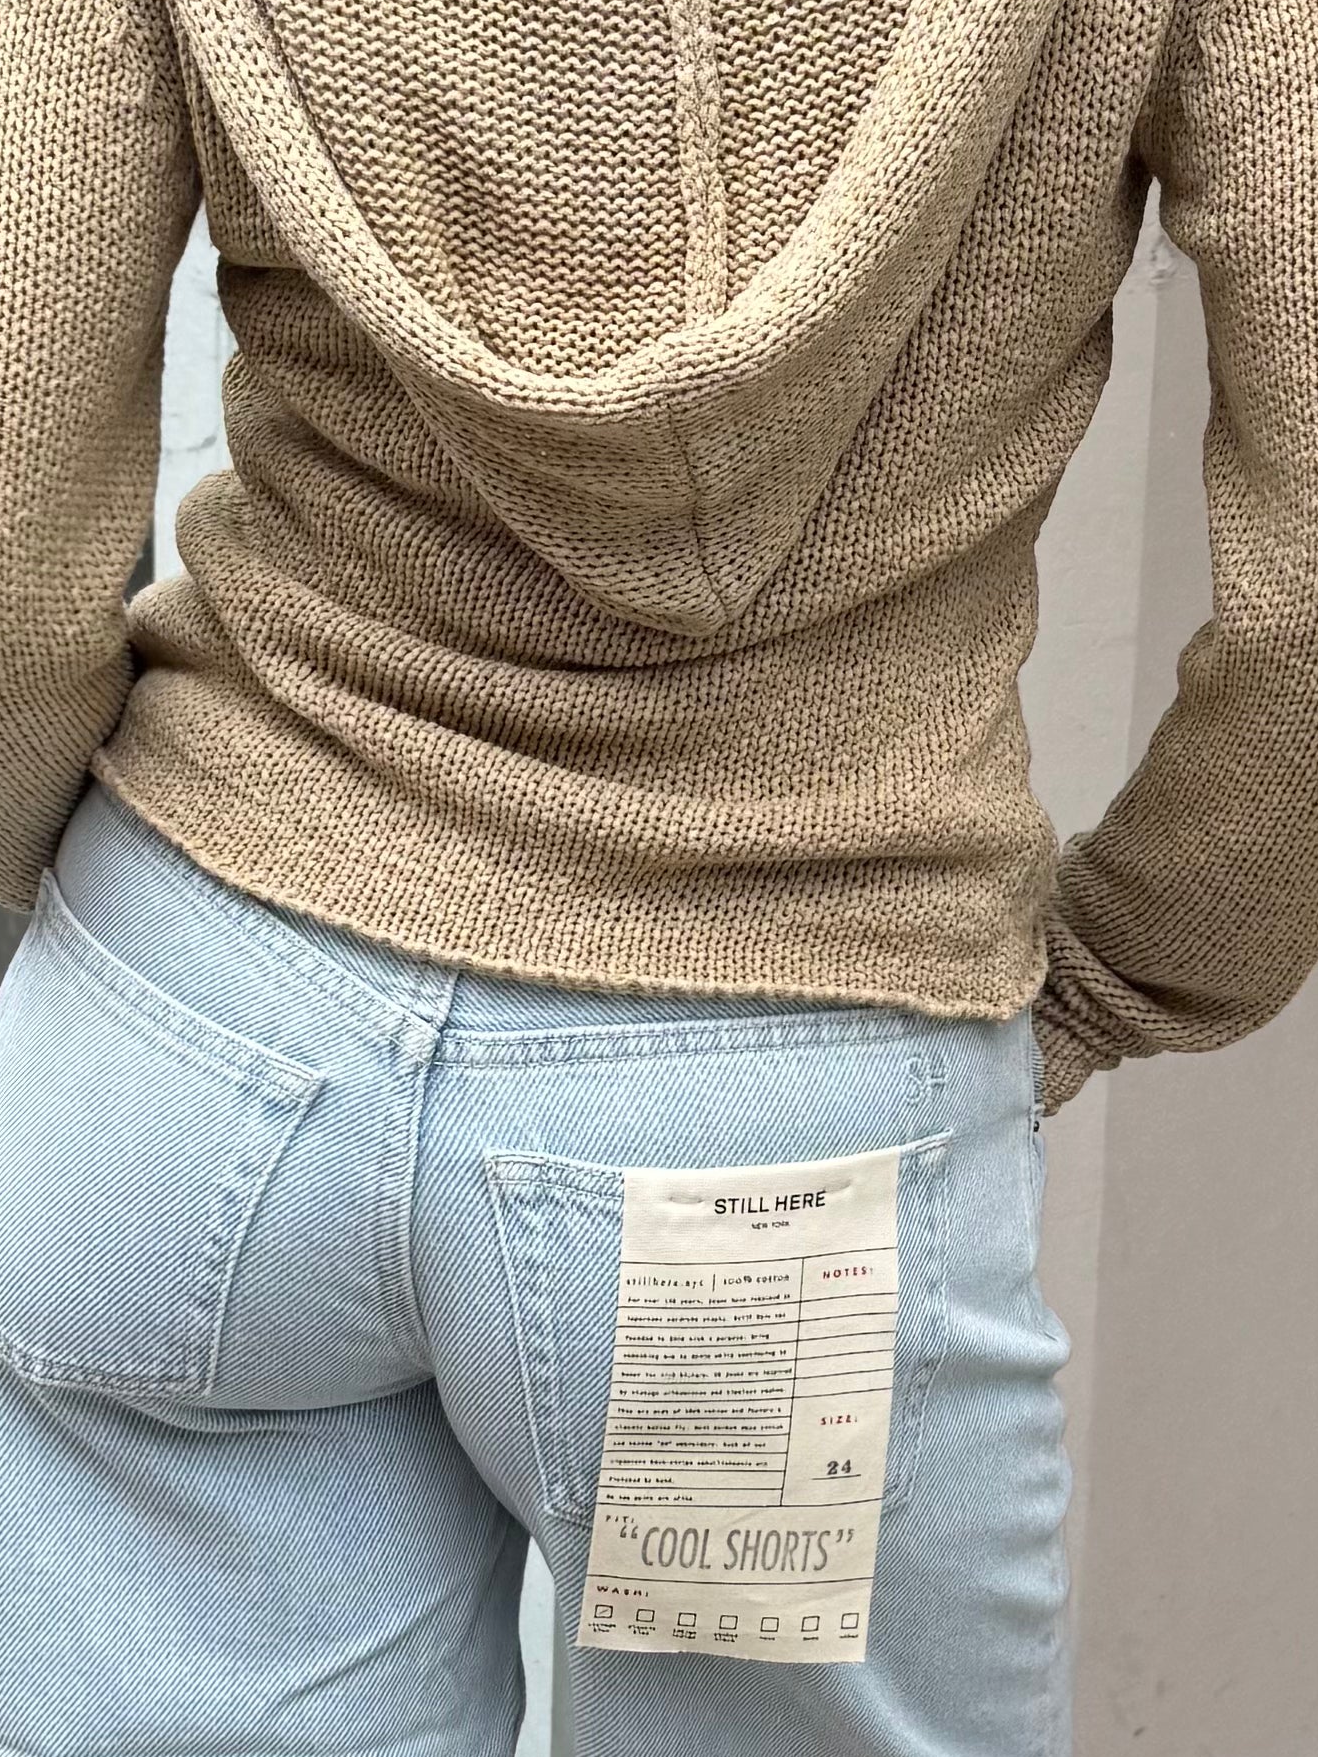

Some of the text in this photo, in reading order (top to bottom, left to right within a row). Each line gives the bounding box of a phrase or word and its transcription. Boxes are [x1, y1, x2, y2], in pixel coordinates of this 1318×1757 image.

[714, 1190, 826, 1215] STILL HERE
[826, 1459, 852, 1476] 24
